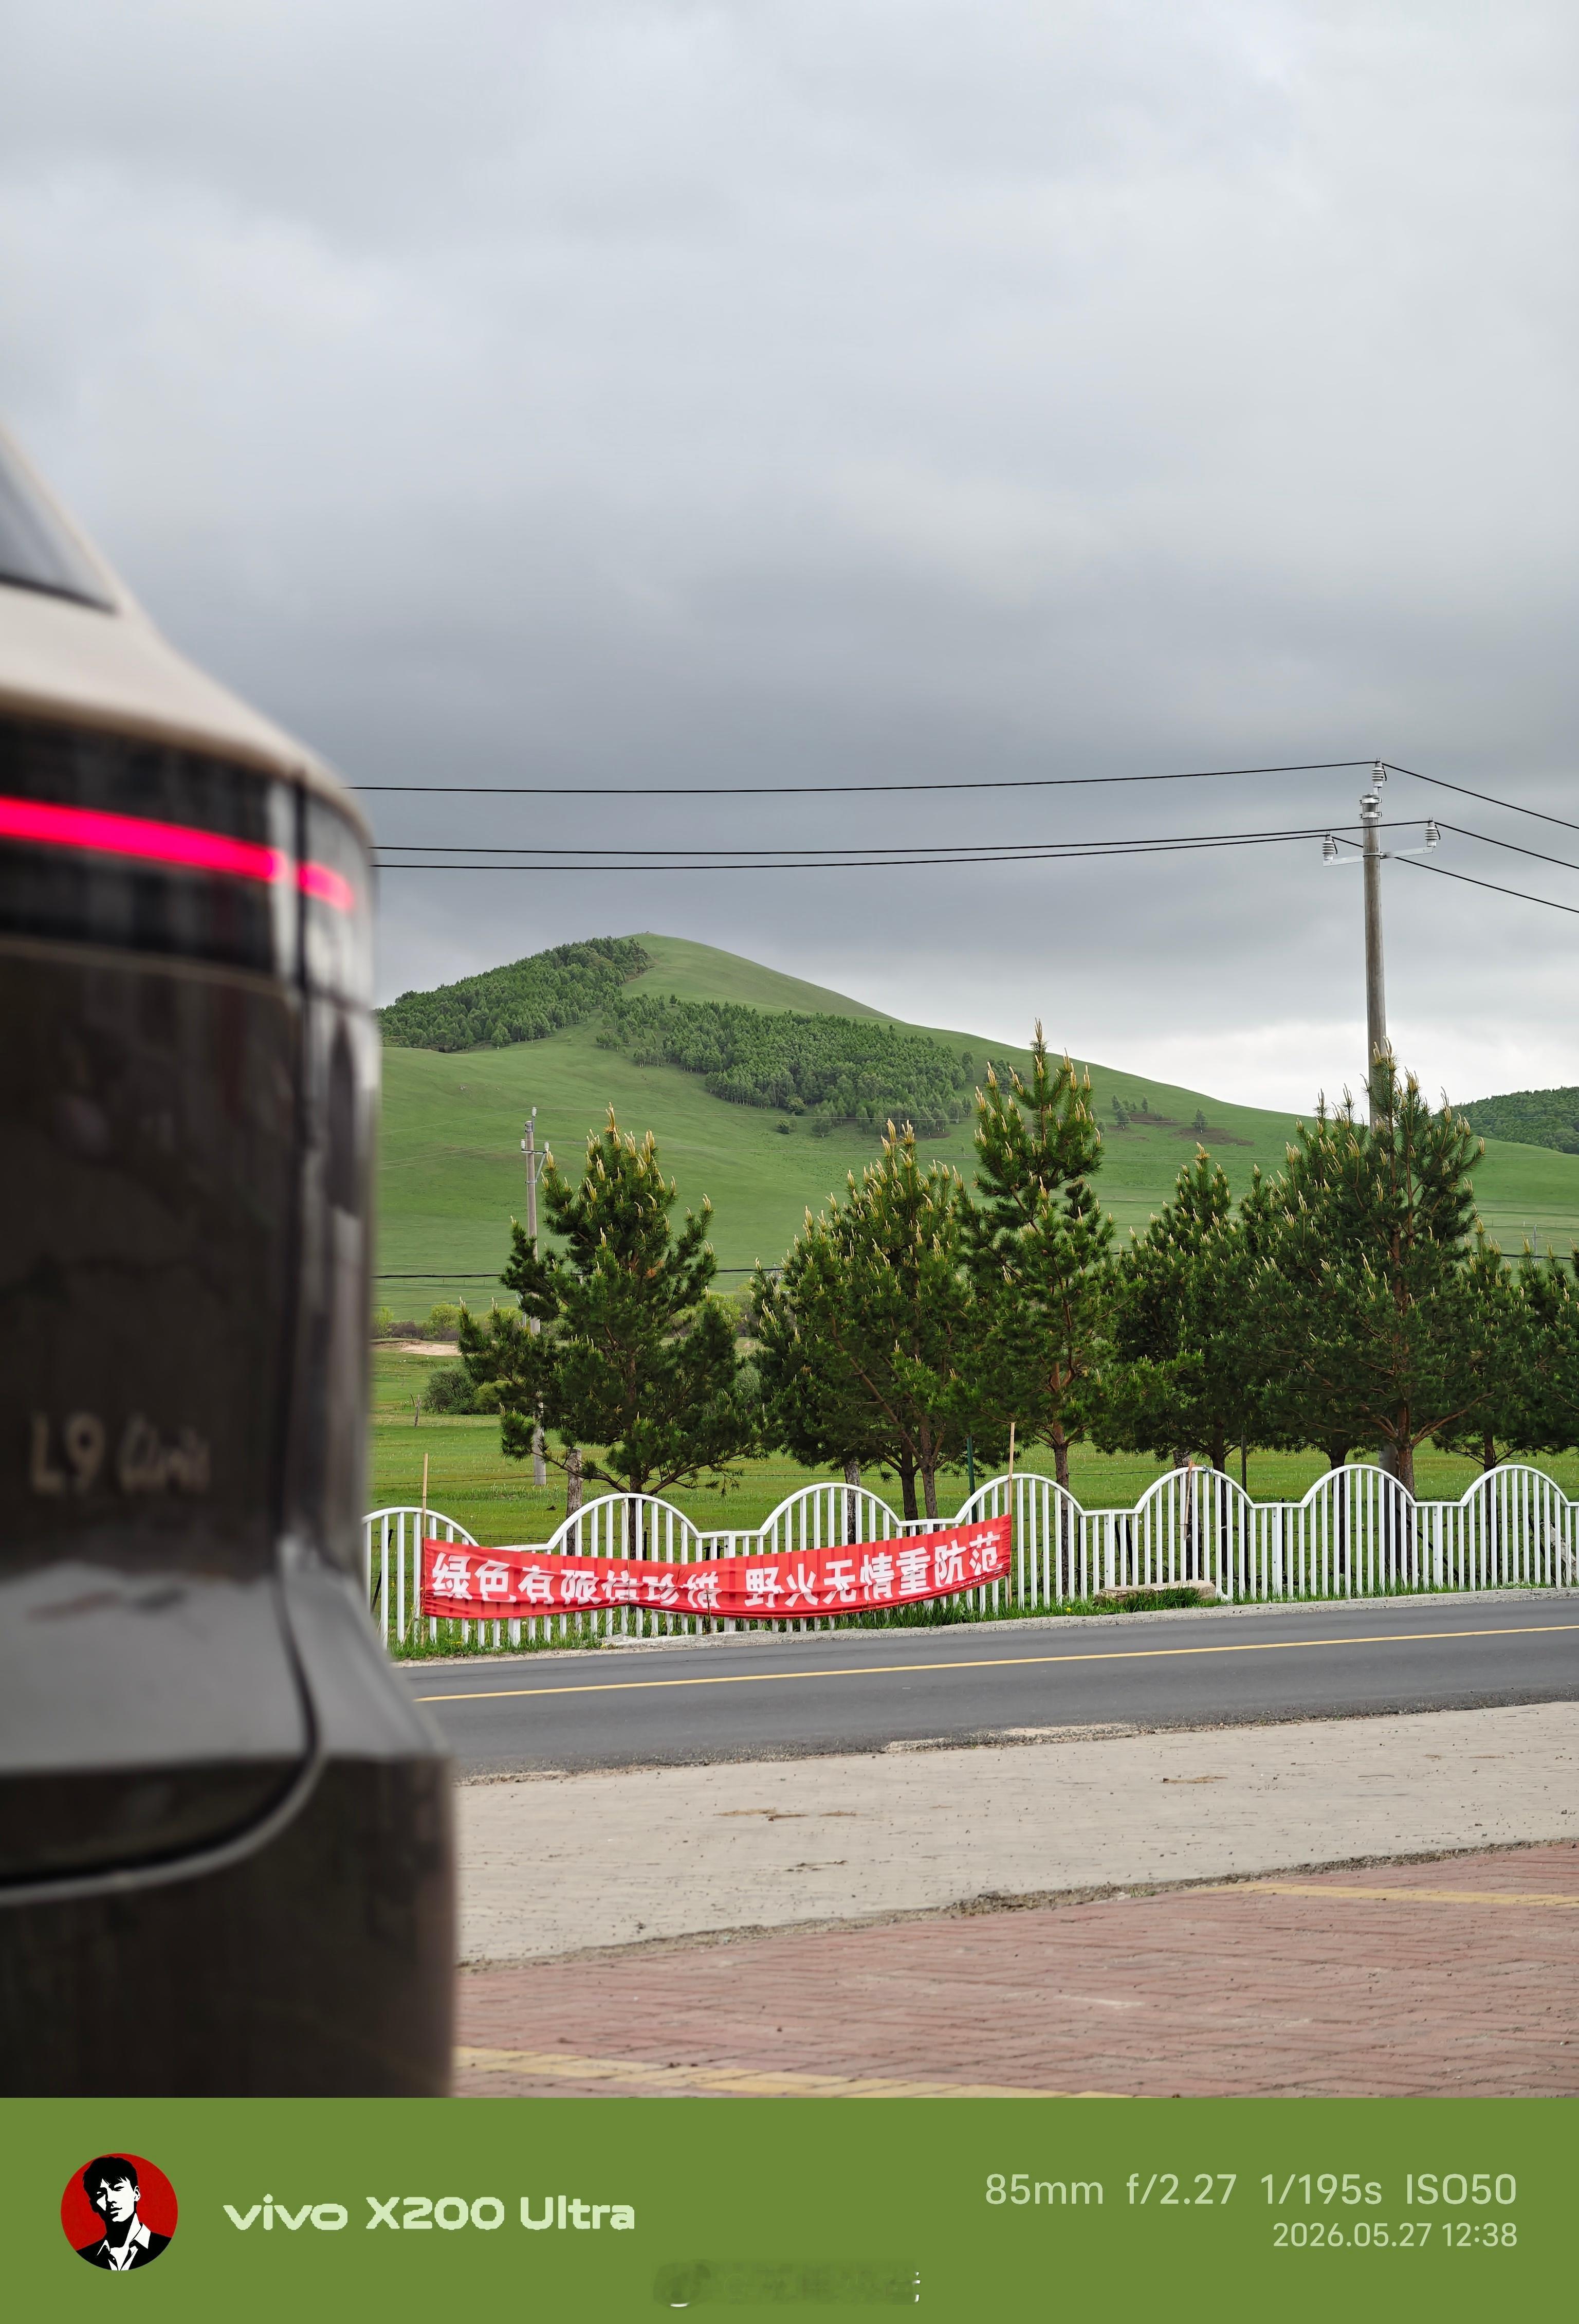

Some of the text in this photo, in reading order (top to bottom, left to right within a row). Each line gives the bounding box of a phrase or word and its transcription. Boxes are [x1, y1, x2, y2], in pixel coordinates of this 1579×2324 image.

[31, 1410, 104, 1495] L9
[744, 1530, 1003, 1609] 野火无情重防范
